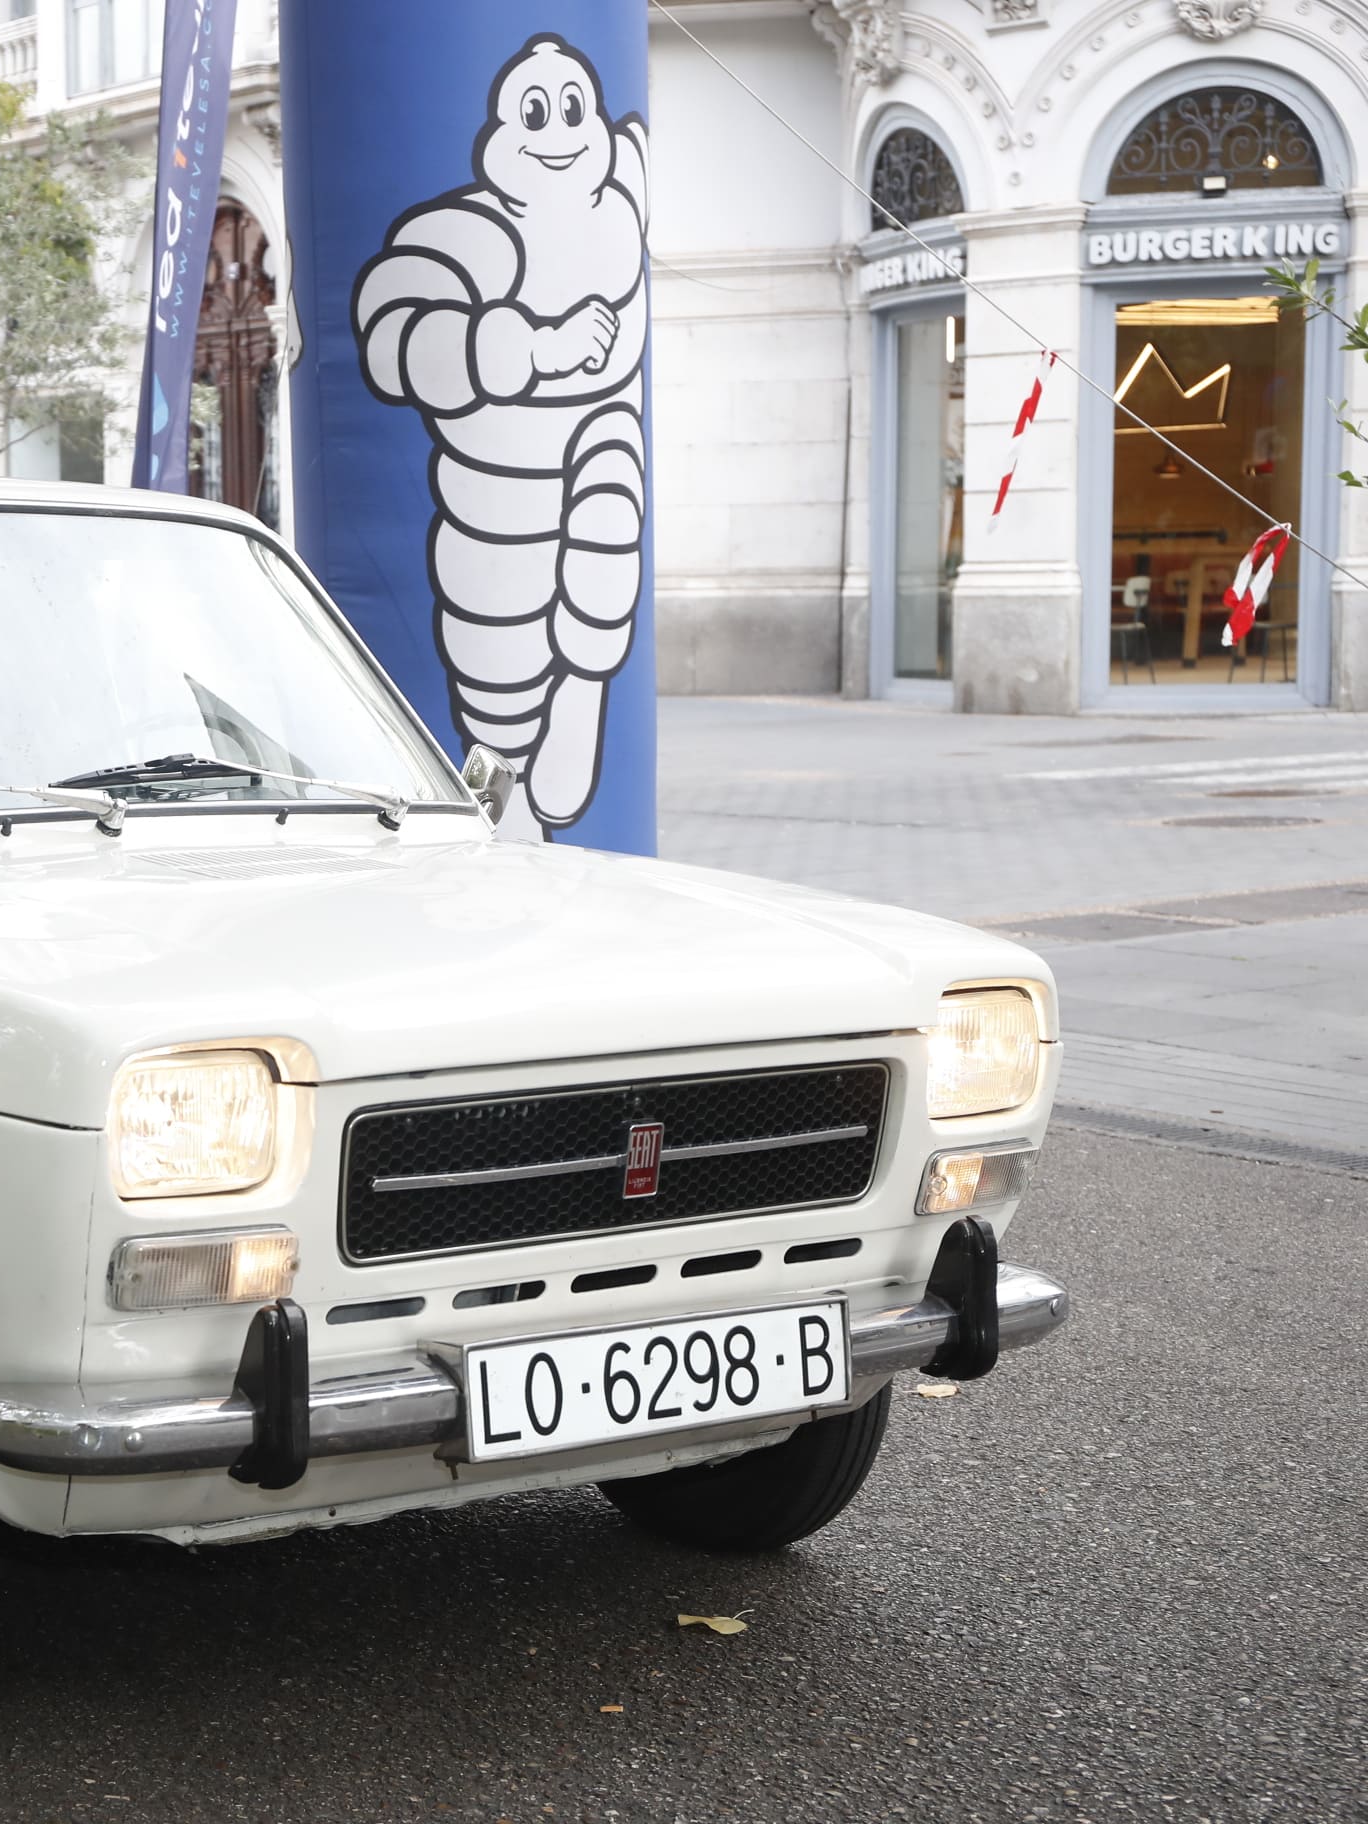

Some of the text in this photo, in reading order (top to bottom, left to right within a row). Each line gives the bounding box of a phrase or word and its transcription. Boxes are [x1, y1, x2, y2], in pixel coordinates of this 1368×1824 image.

[1088, 223, 1340, 266] BURGER KING
[906, 246, 964, 283] KING
[627, 1130, 660, 1169] SEAT
